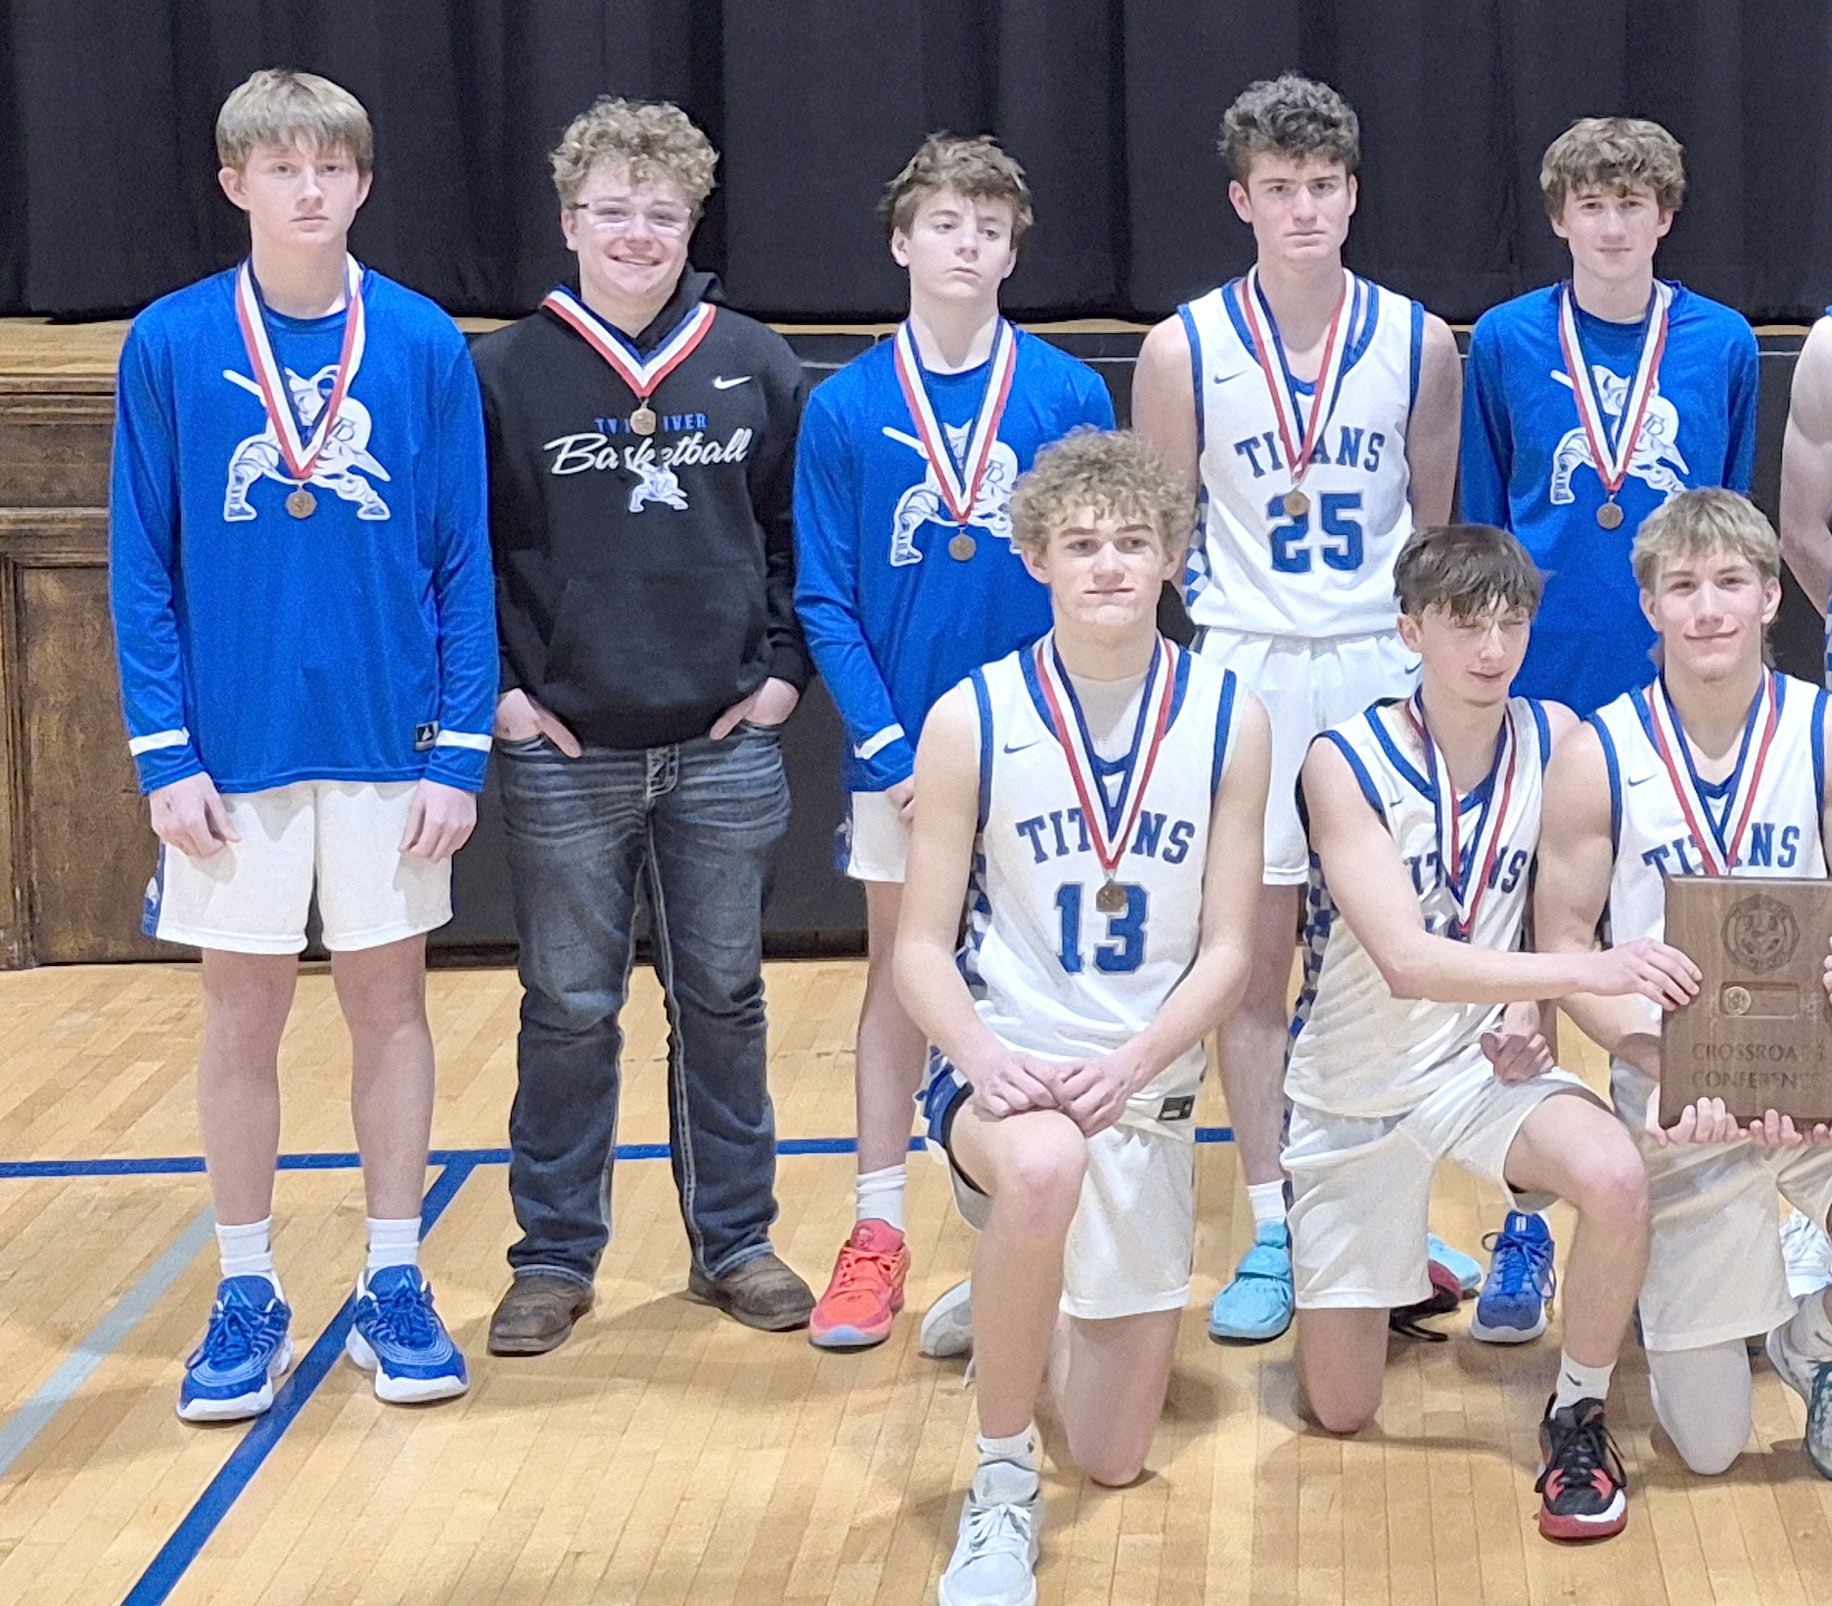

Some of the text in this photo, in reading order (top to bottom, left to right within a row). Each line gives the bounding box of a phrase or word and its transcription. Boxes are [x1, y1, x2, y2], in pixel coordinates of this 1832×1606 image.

[594, 412, 708, 434] TWI IVER
[1233, 424, 1385, 479] TIANS
[1266, 490, 1364, 574] 25
[1015, 806, 1196, 864] TITNS
[1641, 822, 1800, 876] TINS
[1054, 882, 1149, 974] 13
[1692, 1042, 1824, 1062] CROSSROAS
[1692, 1071, 1824, 1090] CONFEREN
